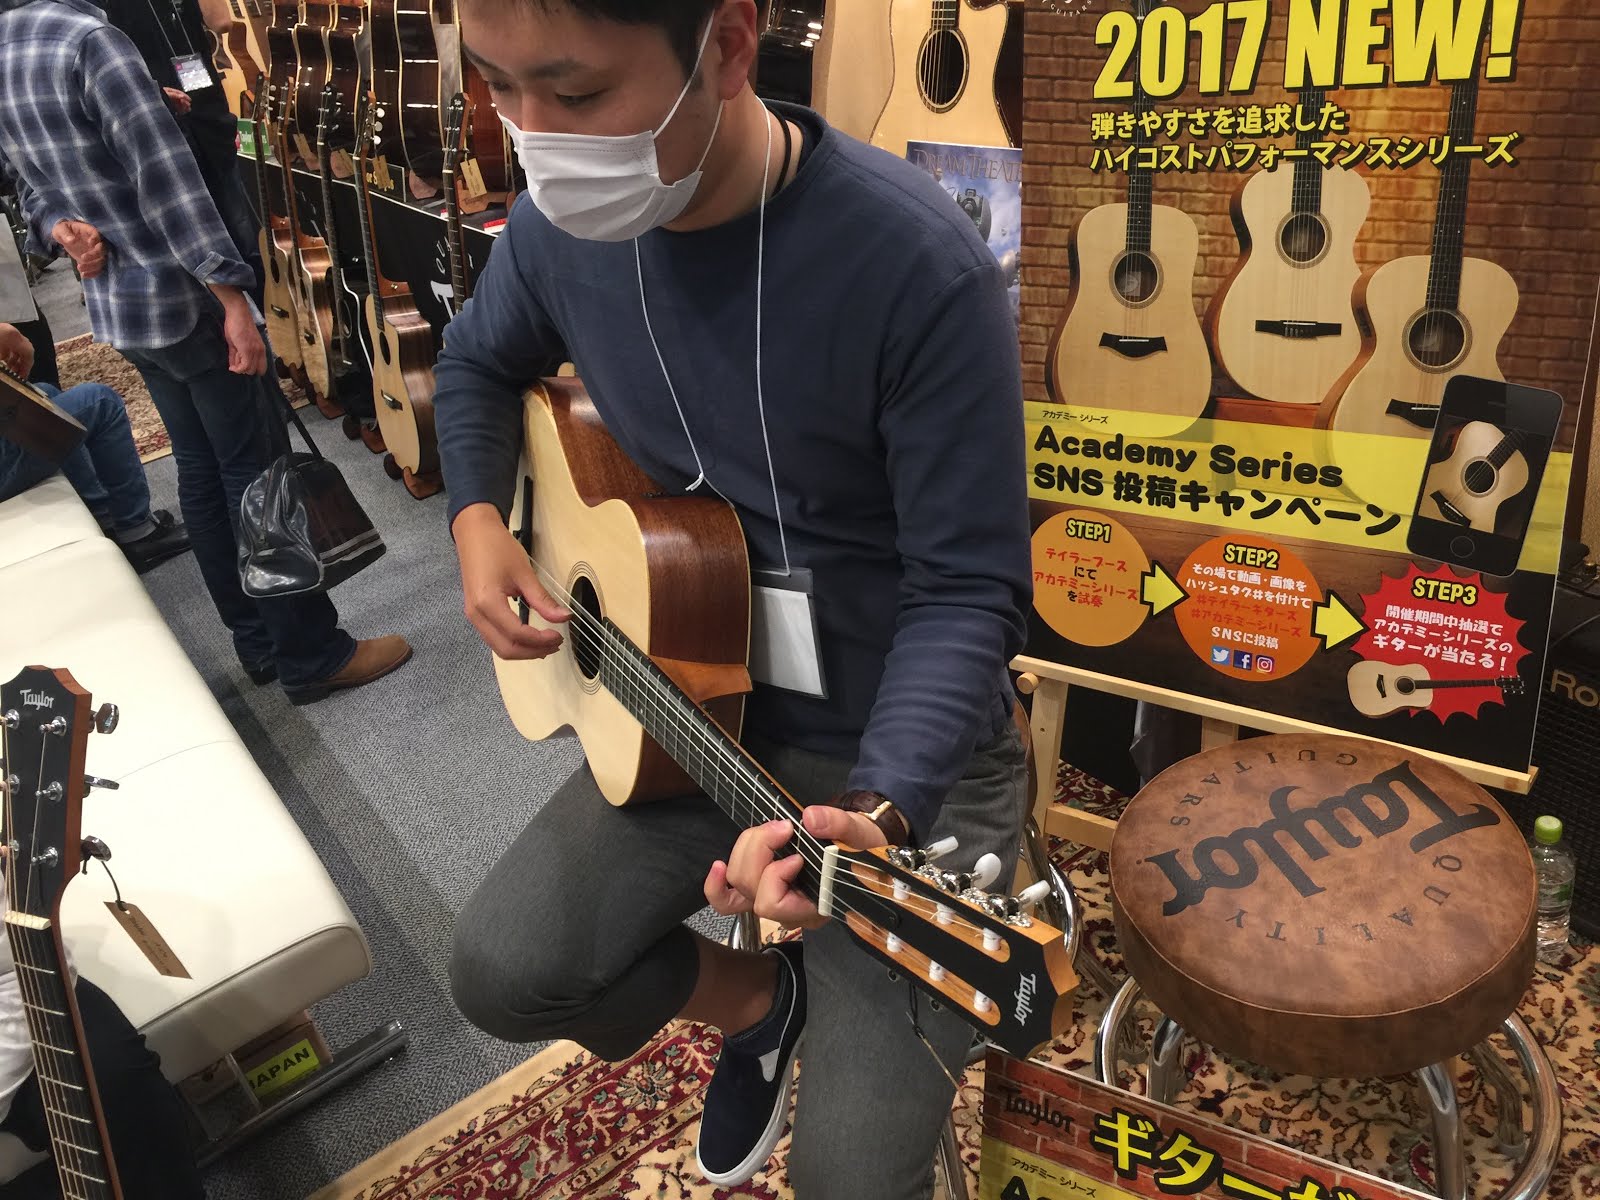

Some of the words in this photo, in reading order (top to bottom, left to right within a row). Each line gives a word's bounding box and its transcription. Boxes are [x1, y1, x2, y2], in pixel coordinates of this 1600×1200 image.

[1093, 0, 1268, 99] 2017
[1283, 0, 1518, 89] NEW!
[1090, 102, 1346, 140] 弾きやすさを追求した
[1090, 131, 1519, 171] ハイコストパフォーマンスシリーズ
[1034, 425, 1198, 473] Academy
[1208, 444, 1343, 488] Series
[1033, 462, 1104, 496] SNS
[1113, 470, 1401, 536] 投稿キャンペーン
[1065, 518, 1112, 543] STEP1
[1073, 566, 1097, 580] にて
[1223, 543, 1280, 570] STEP2
[1192, 563, 1307, 592] その場で動画・画像を
[1411, 576, 1479, 607] STEP3
[1211, 626, 1279, 650] SNSに投稿
[1374, 618, 1513, 654] アカデミーシリーズの
[1385, 604, 1504, 637] 開催期間中抽選で
[19, 688, 55, 711] Taylor
[1550, 668, 1600, 708] Ro
[1170, 748, 1359, 828] GUITARS
[1143, 759, 1501, 917] Taylor
[1225, 853, 1463, 946] QUALITY
[1013, 971, 1037, 1027] Taylor
